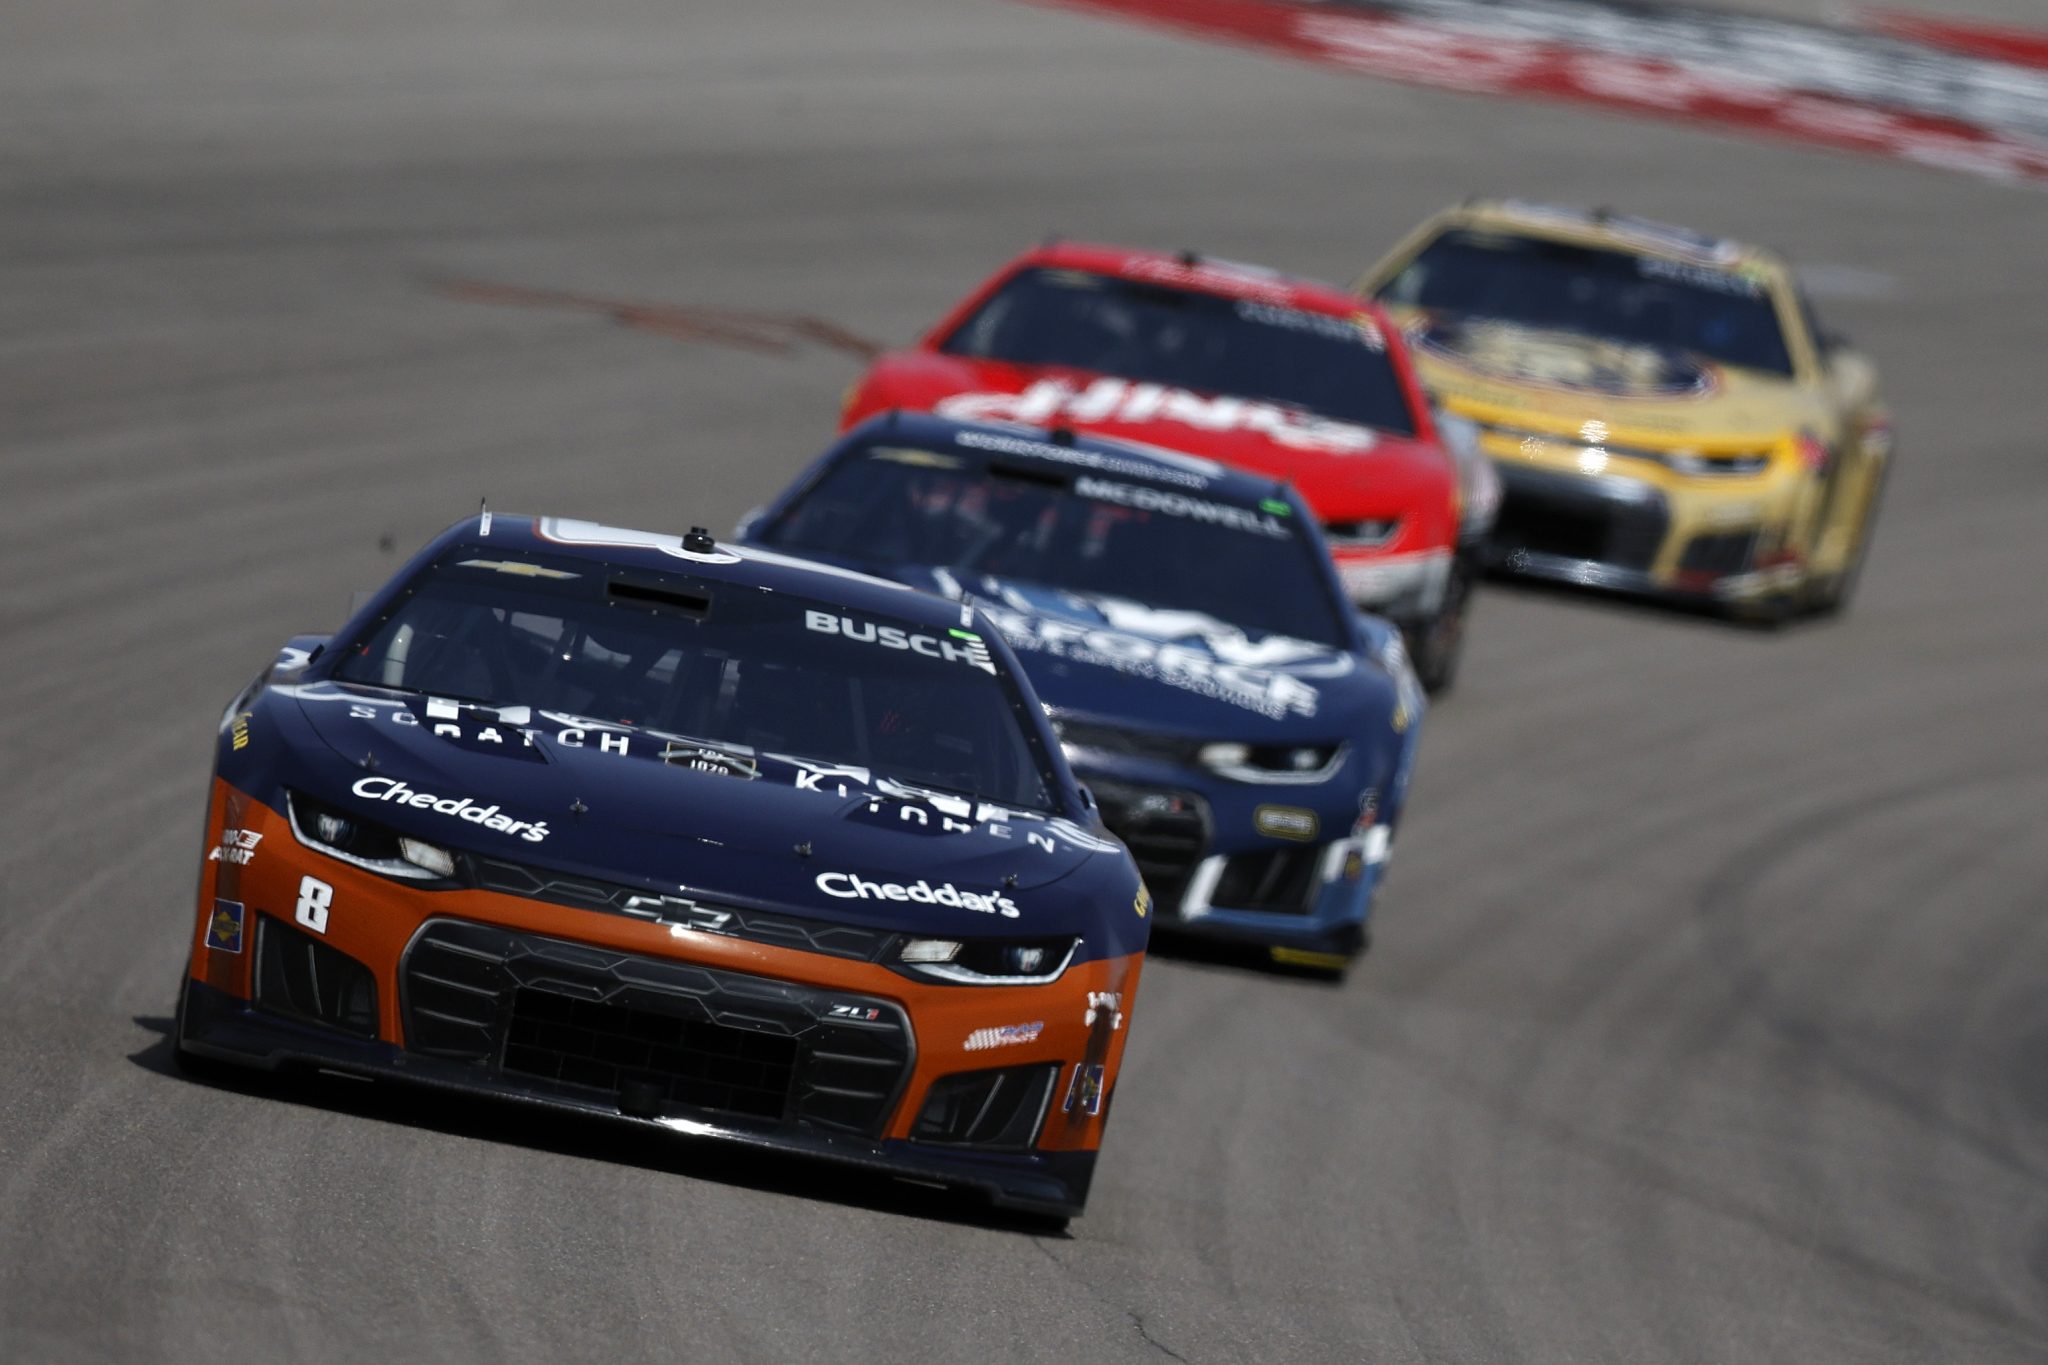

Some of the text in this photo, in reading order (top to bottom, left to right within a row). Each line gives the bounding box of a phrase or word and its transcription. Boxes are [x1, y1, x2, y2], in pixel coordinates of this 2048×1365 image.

[805, 610, 980, 668] BUSCH
[352, 776, 550, 842] Cheddar's
[295, 875, 333, 934] 8
[815, 872, 1020, 918] Cheddar's
